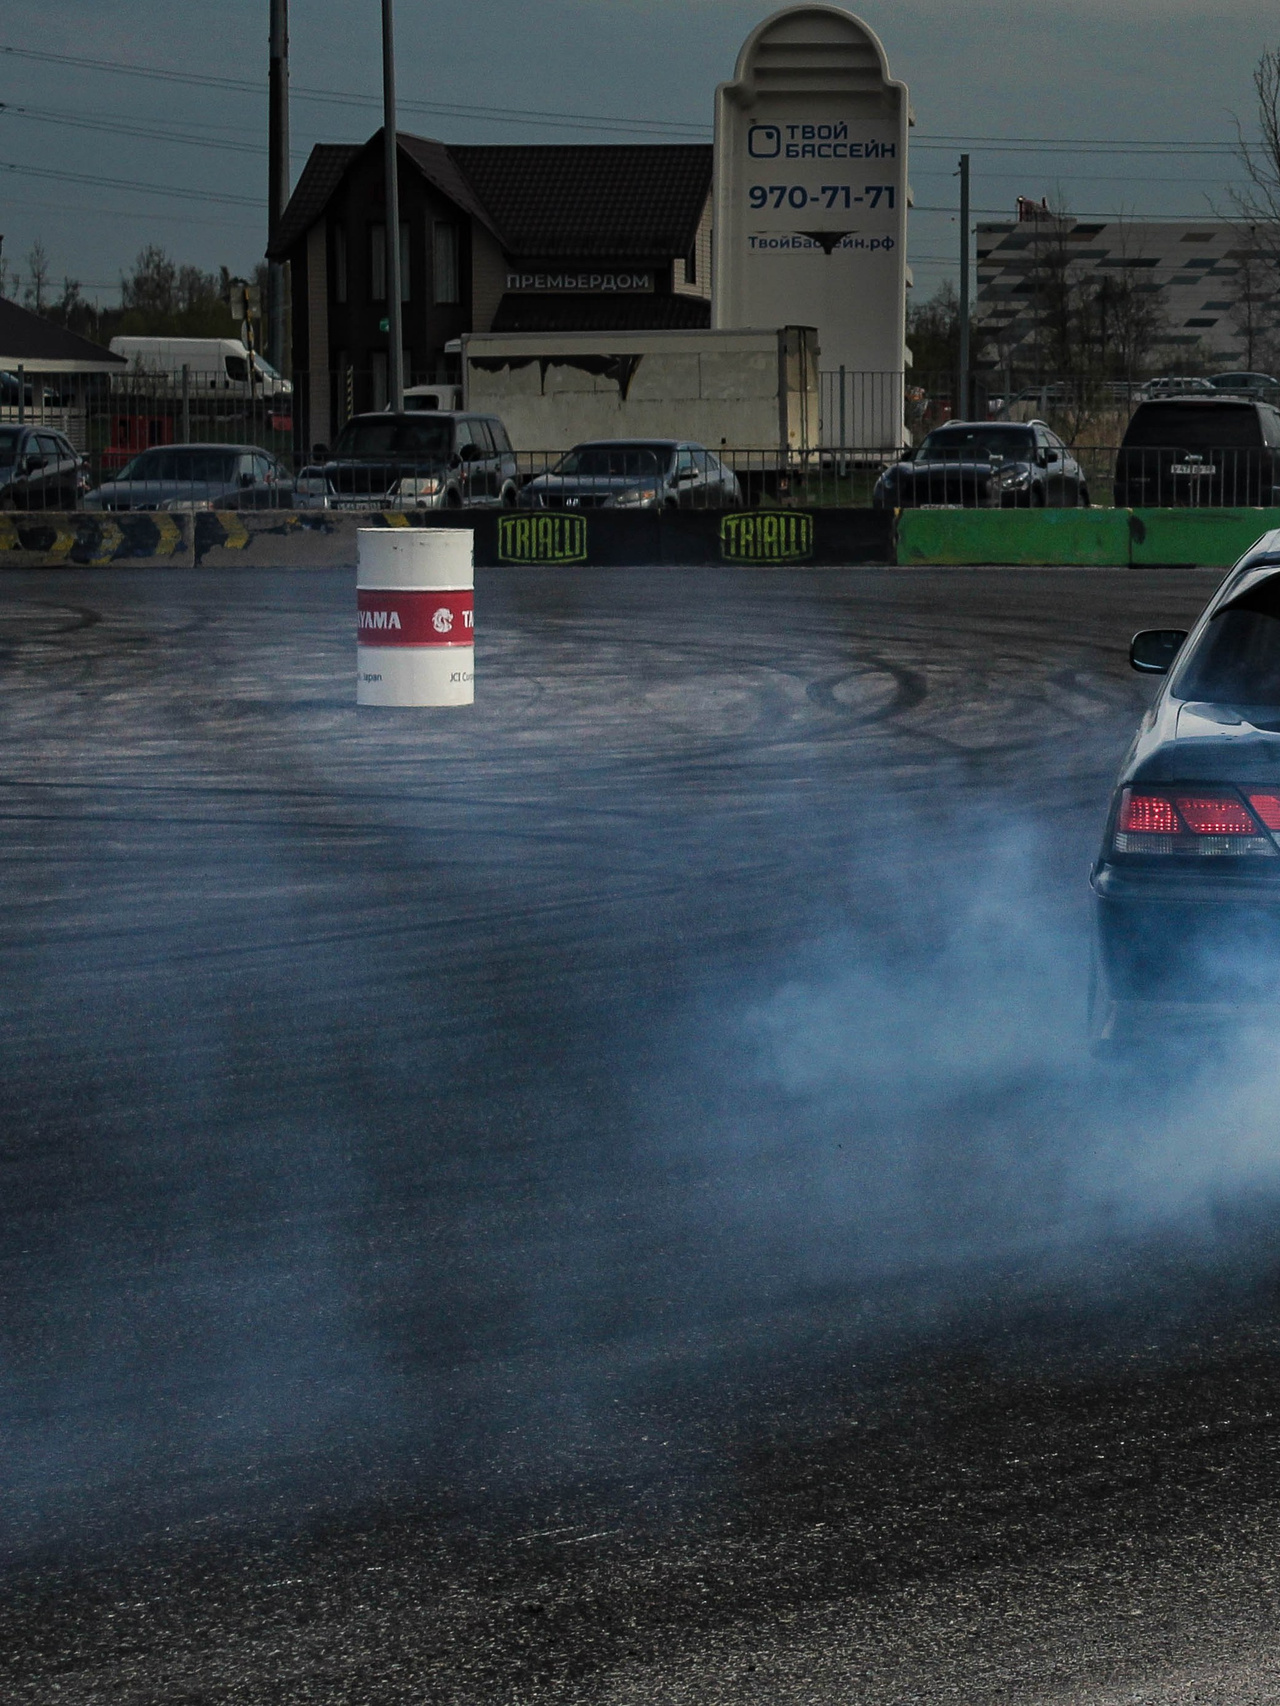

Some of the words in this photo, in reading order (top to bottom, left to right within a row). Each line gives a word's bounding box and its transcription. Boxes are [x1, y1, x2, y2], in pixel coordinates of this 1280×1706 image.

[785, 120, 848, 140] ТВОЙ
[785, 139, 896, 159] БАССЕЙН
[749, 185, 895, 209] 970-71-71
[748, 235, 895, 252] ТвойБасйн.рф
[506, 274, 650, 290] ПРЕМЬЕРДОМ
[503, 517, 581, 557] TRIALLI
[726, 515, 807, 557] TRIALLI
